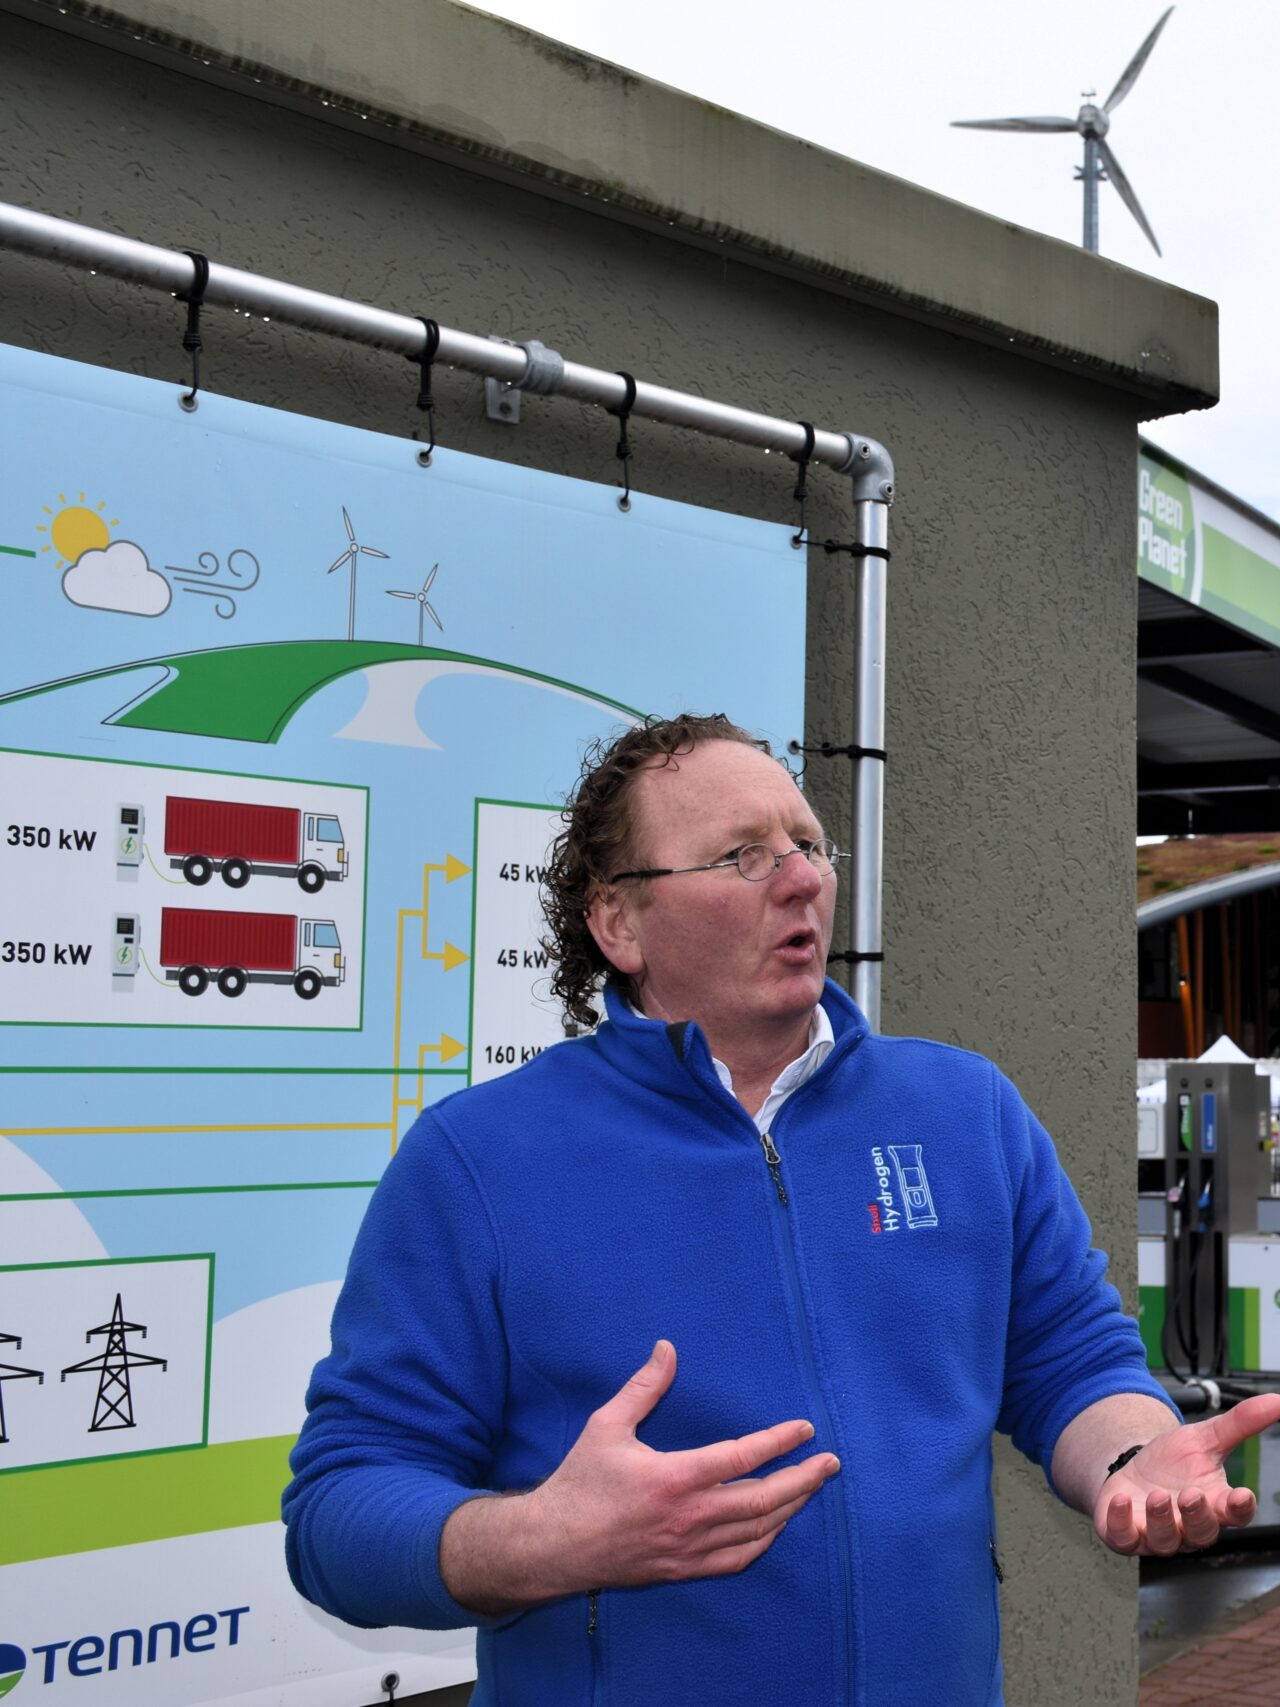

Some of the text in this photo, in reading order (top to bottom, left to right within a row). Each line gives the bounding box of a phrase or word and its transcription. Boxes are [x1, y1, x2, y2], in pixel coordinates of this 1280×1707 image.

[1139, 469, 1183, 532] Green
[1139, 516, 1187, 579] Planet
[7, 825, 97, 852] 350 kW
[499, 863, 520, 881] 45
[1, 941, 92, 966] 350 kW
[497, 949, 552, 968] 45 kW
[485, 1045, 515, 1064] 160
[871, 1146, 901, 1231] Hydrogen
